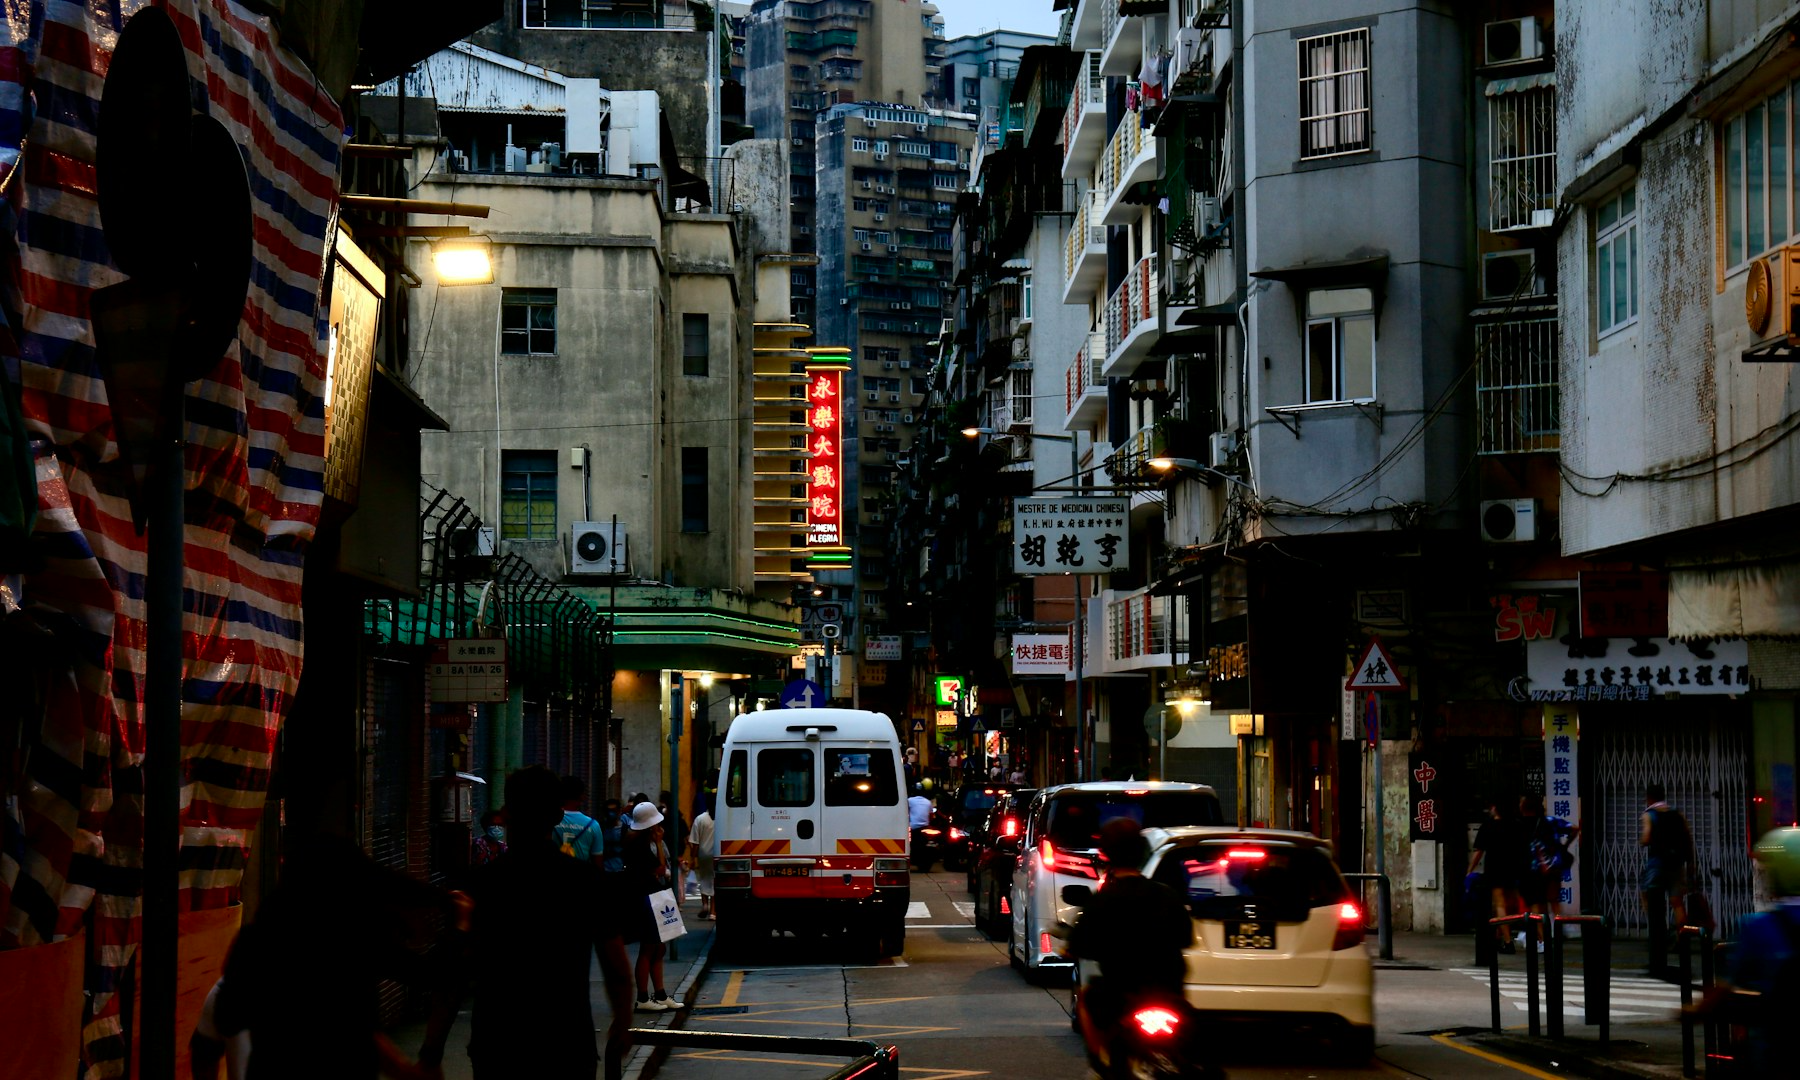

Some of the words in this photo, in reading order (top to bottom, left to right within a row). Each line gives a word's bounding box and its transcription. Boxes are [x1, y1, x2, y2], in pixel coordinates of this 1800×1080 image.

[1018, 504, 1046, 513] MESTRE
[1049, 504, 1058, 513] DE
[1062, 504, 1093, 513] MEDICINA
[1096, 504, 1125, 513] CHINESA
[809, 534, 839, 543] ALEGRIA
[1494, 607, 1556, 642] SW
[436, 666, 442, 674] 8
[451, 666, 464, 674] 8A
[469, 666, 485, 674] 18A
[490, 665, 502, 674] 26
[1413, 760, 1437, 833] 中醫
